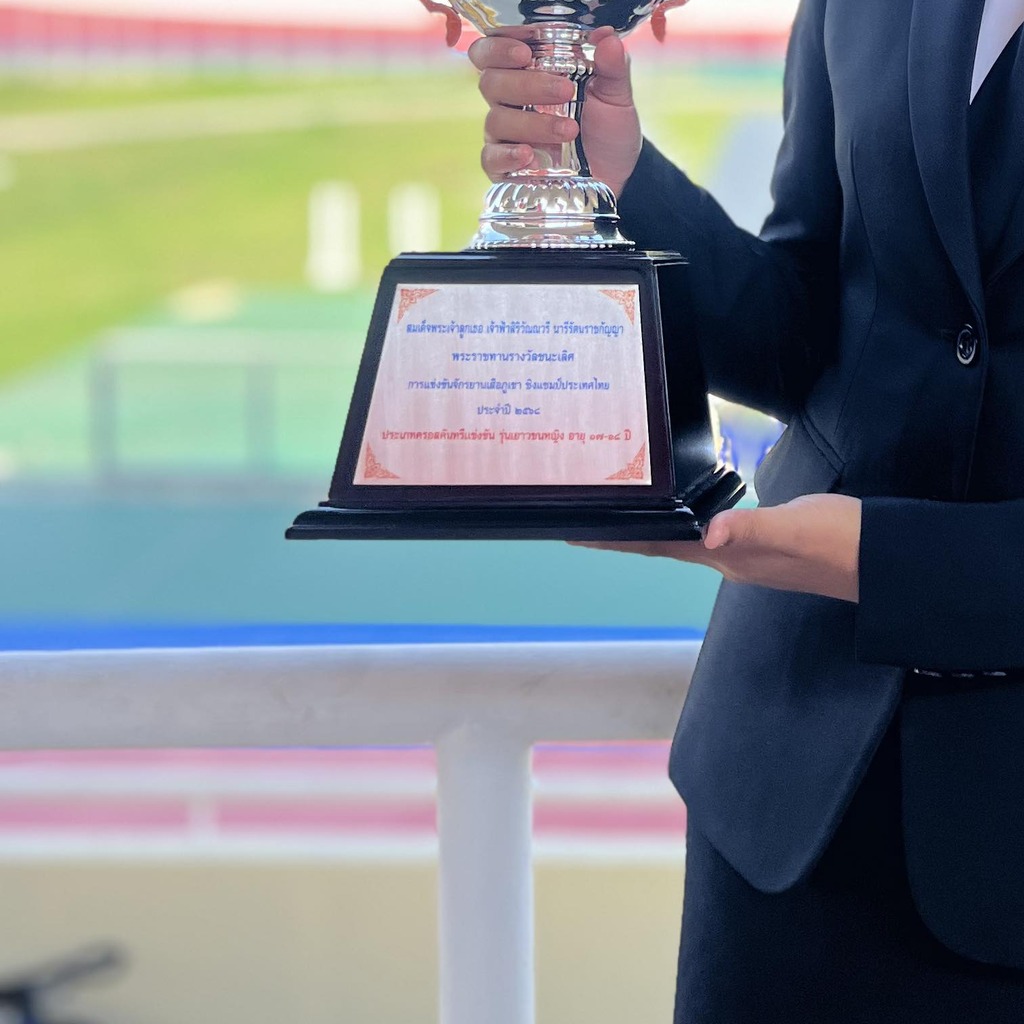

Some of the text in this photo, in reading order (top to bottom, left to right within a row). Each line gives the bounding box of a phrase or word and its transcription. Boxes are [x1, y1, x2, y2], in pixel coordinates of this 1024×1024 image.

[451, 349, 575, 363] พระราชทานรางวัลชนะเลิศ
[477, 403, 511, 415] ประจำปี
